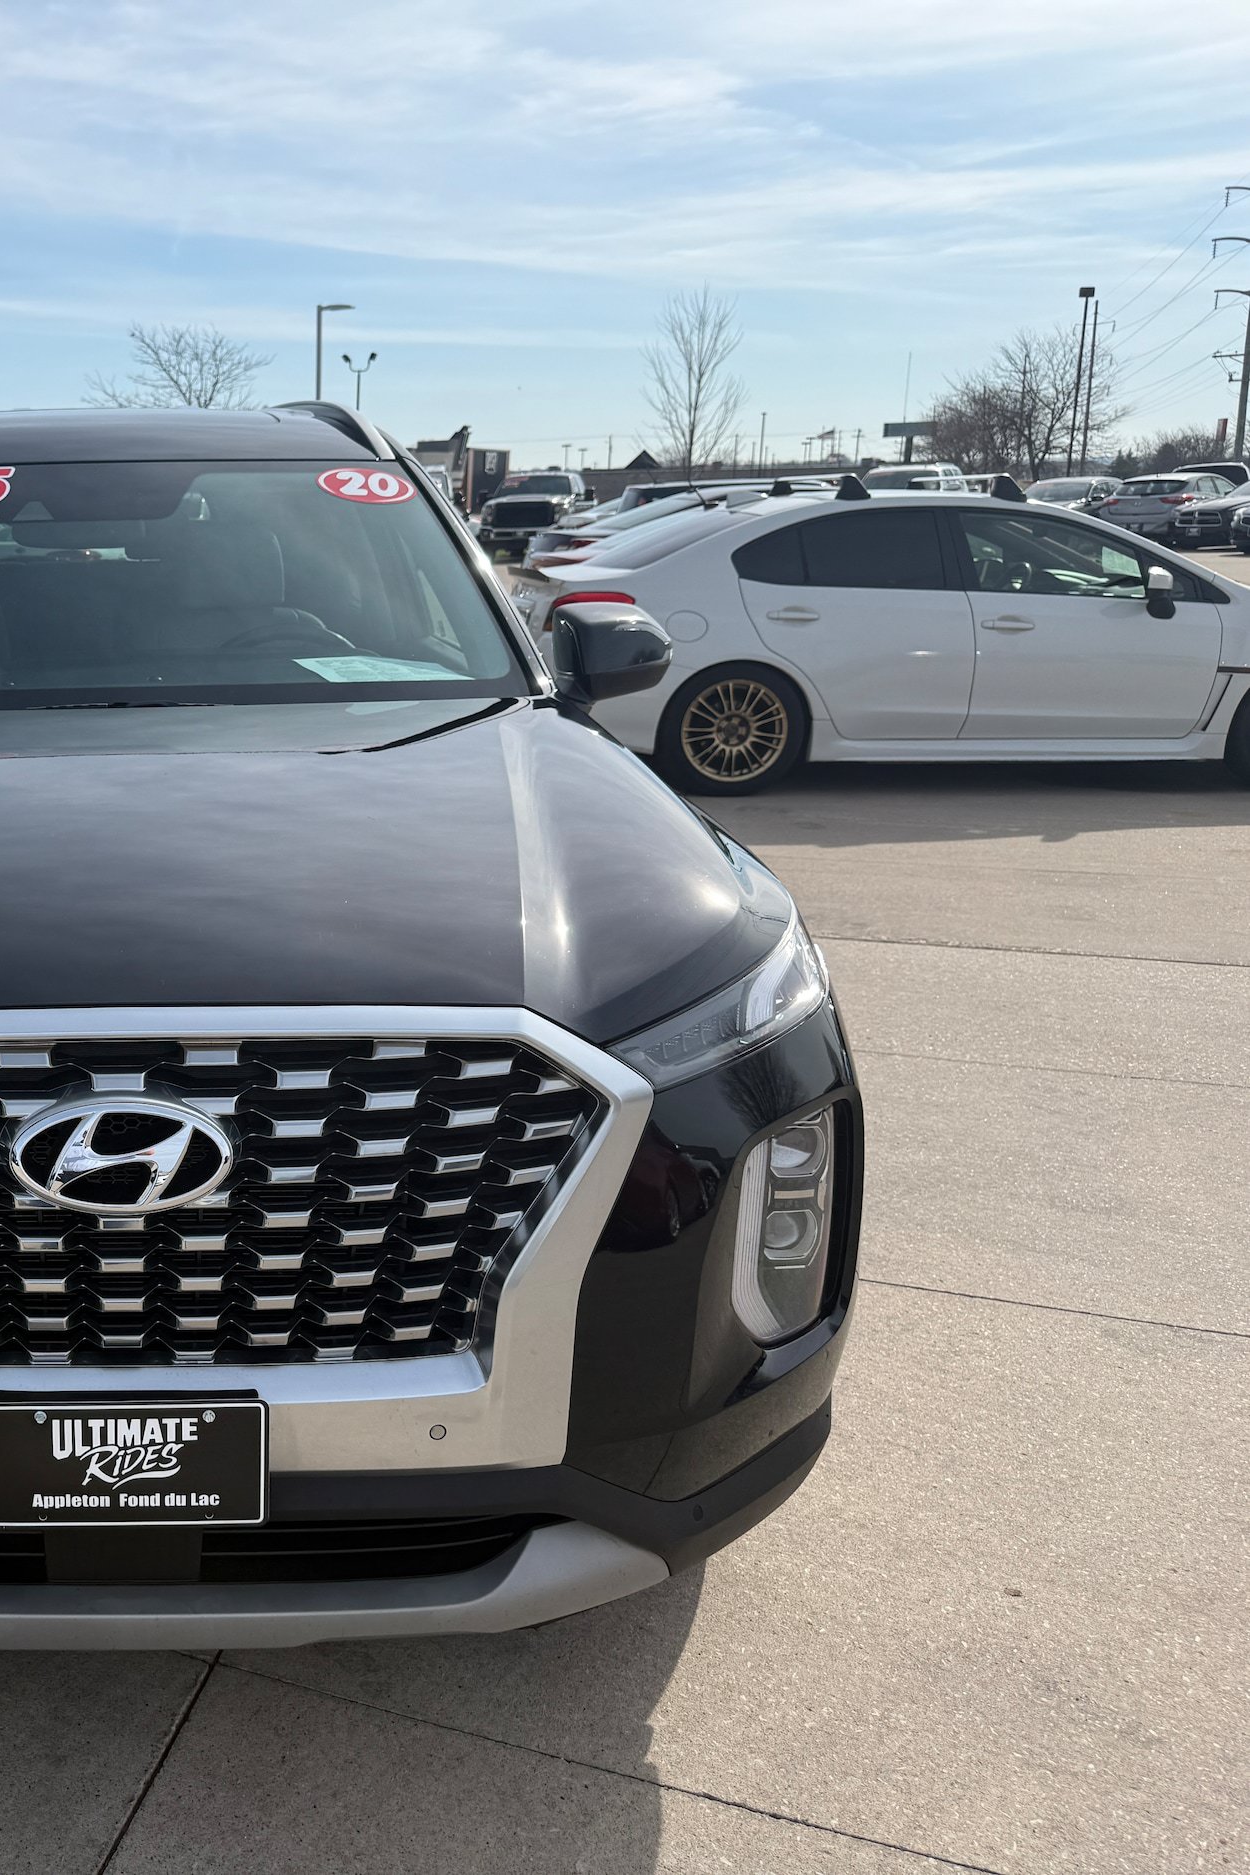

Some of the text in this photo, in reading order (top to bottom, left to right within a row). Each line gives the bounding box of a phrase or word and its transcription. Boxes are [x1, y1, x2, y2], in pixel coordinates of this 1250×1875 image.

[336, 471, 400, 498] 20
[52, 1417, 199, 1460] ULTIMATE
[32, 1493, 220, 1508] Appleton Fond du Lac
